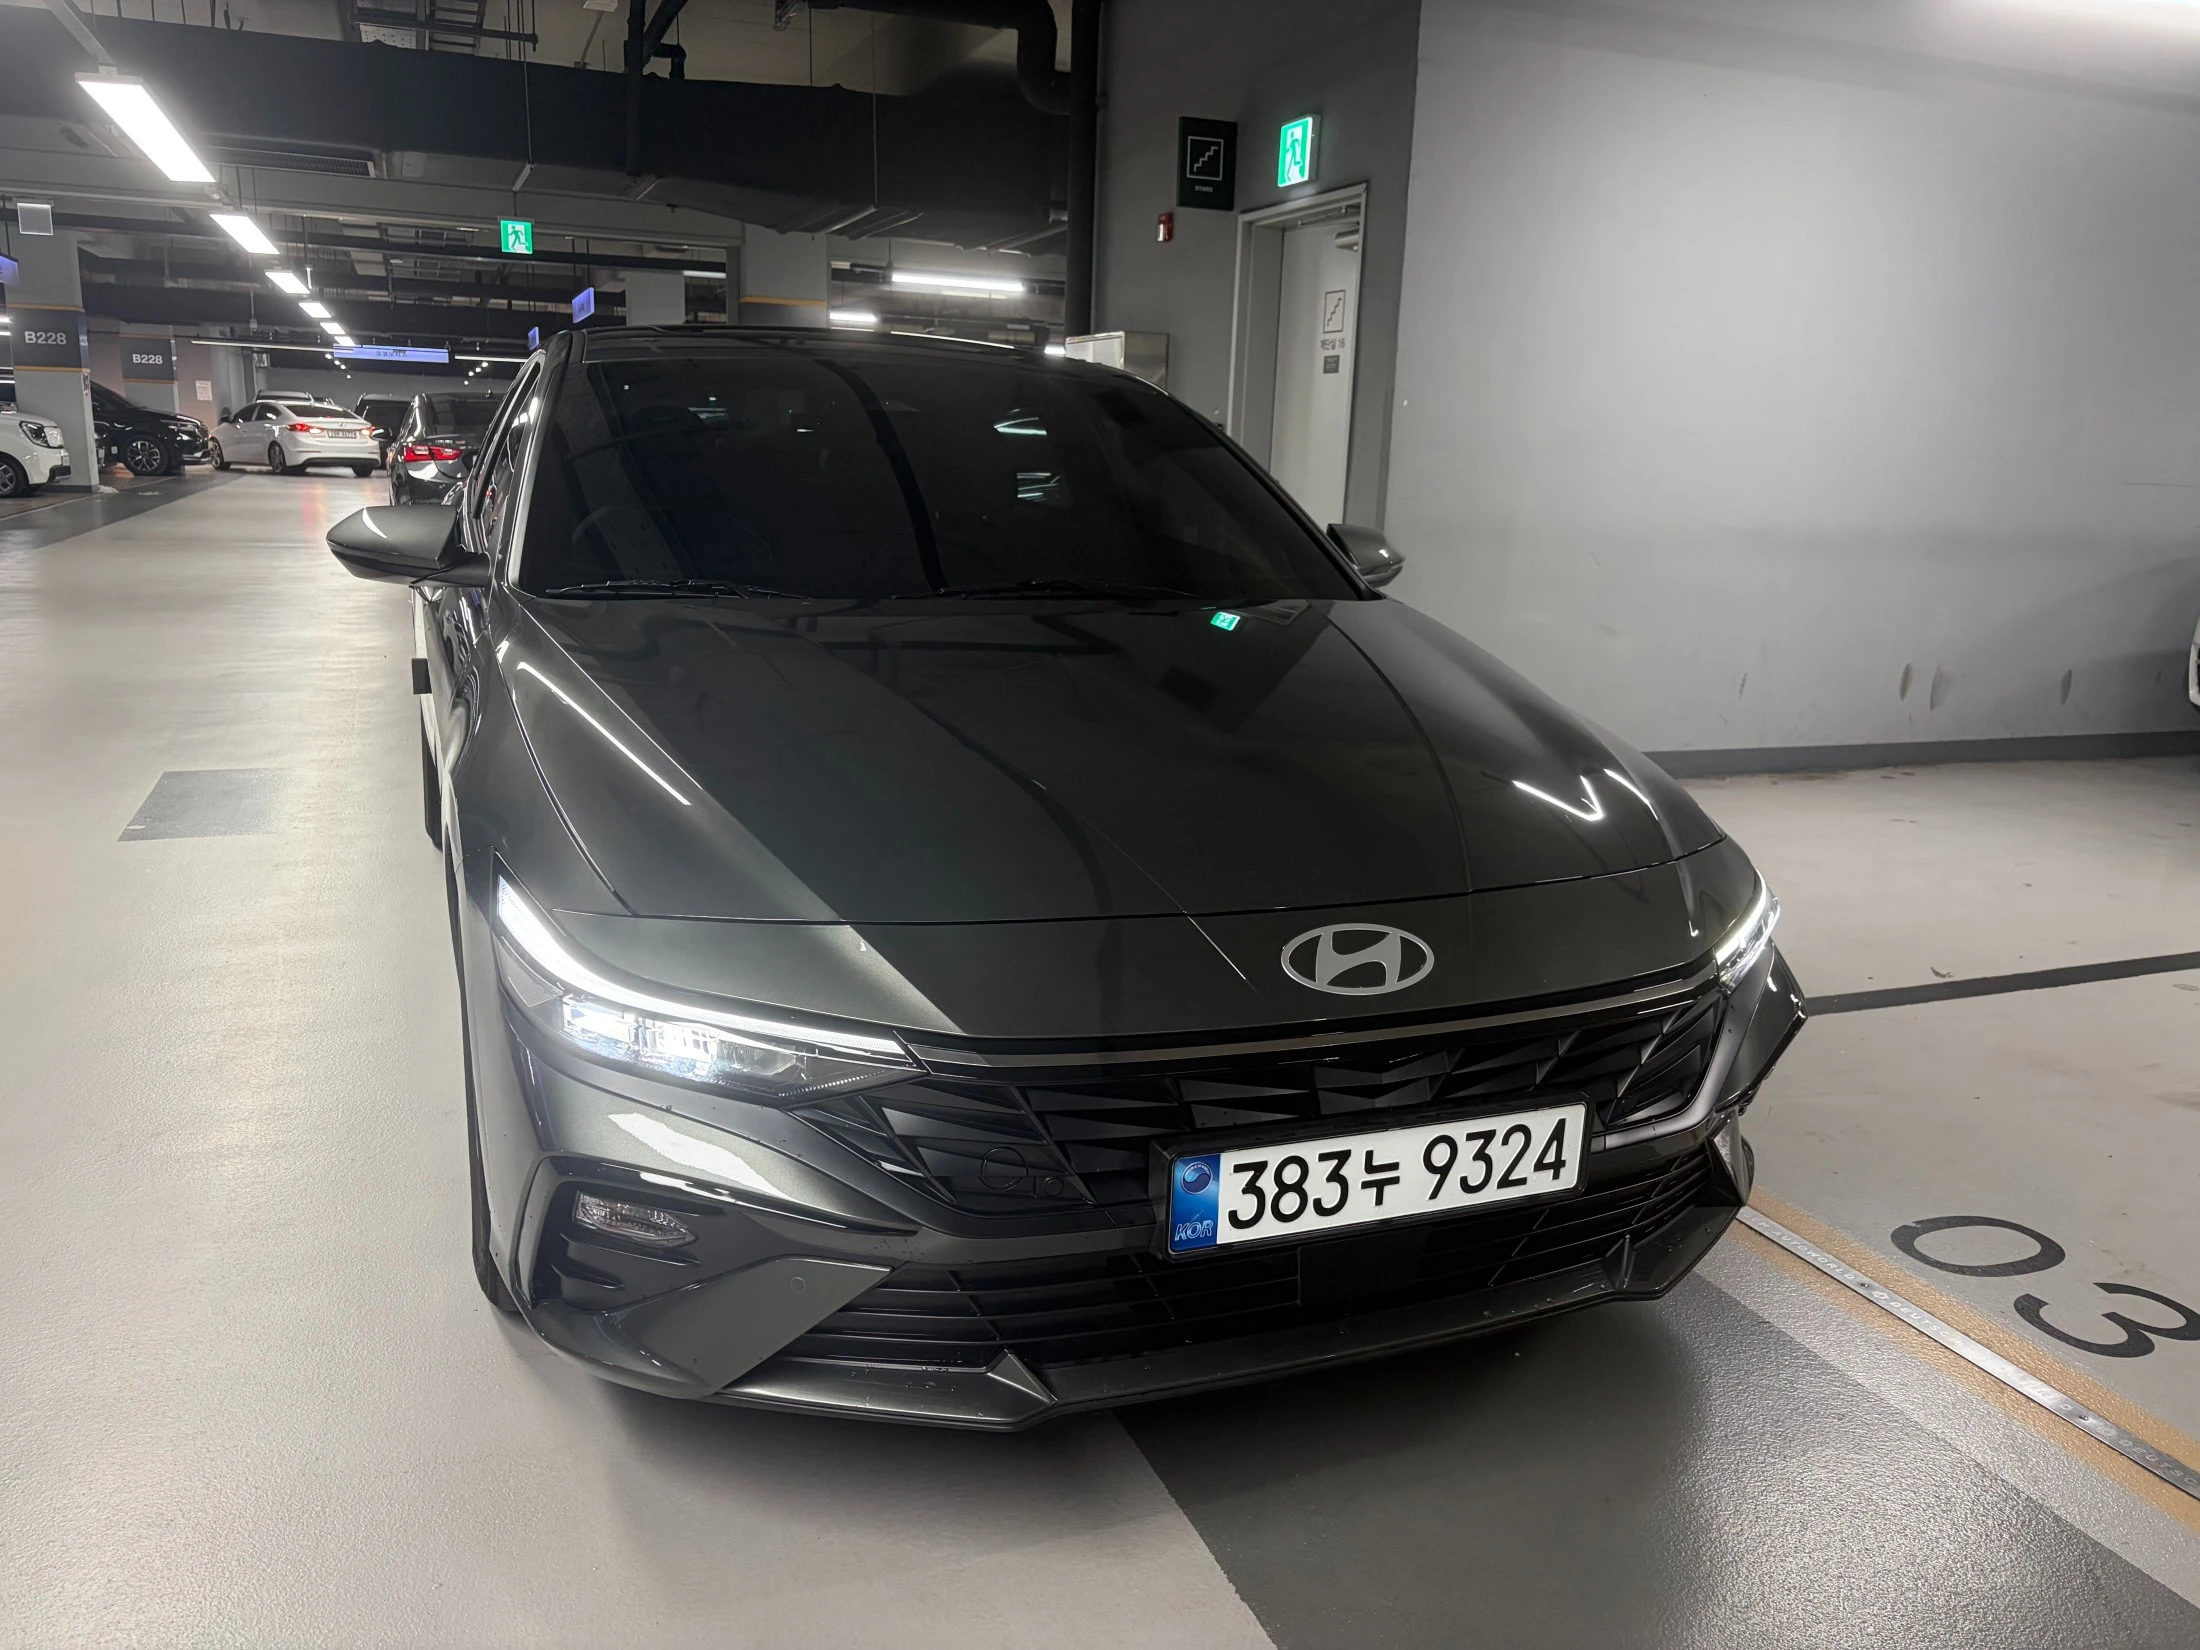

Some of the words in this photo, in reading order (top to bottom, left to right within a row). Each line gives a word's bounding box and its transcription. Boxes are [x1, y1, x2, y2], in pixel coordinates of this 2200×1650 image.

[25, 331, 67, 345] B228
[132, 353, 163, 365] B228
[1228, 1149, 1400, 1230] 383누
[1423, 1118, 1567, 1200] 9324
[1174, 1220, 1213, 1241] KOR
[1771, 1231, 1855, 1279] AUTOWORLD
[2119, 1440, 2198, 1487] DEUTSC
